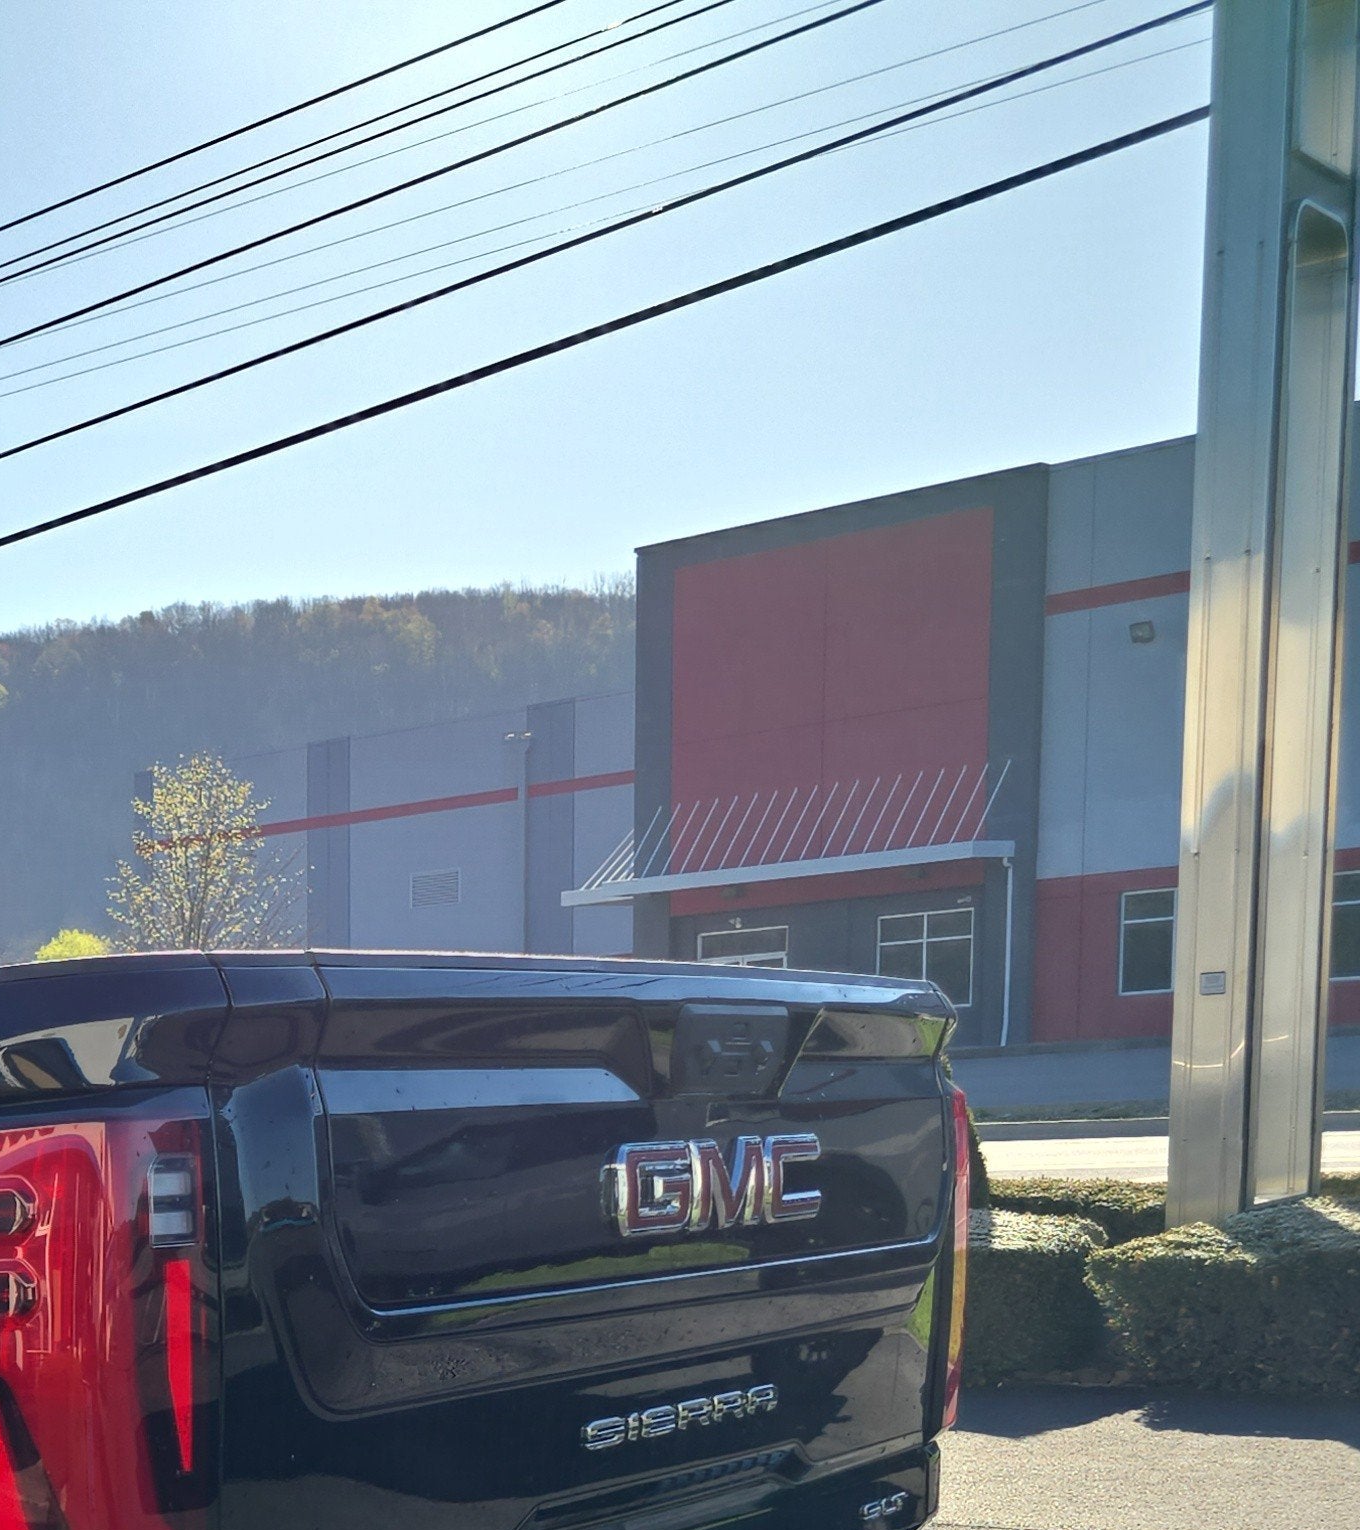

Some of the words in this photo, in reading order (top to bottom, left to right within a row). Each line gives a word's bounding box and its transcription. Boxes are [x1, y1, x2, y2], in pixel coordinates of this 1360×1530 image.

[600, 1134, 822, 1237] GMC
[581, 1383, 778, 1450] SIERRA
[861, 1491, 908, 1520] SLT
